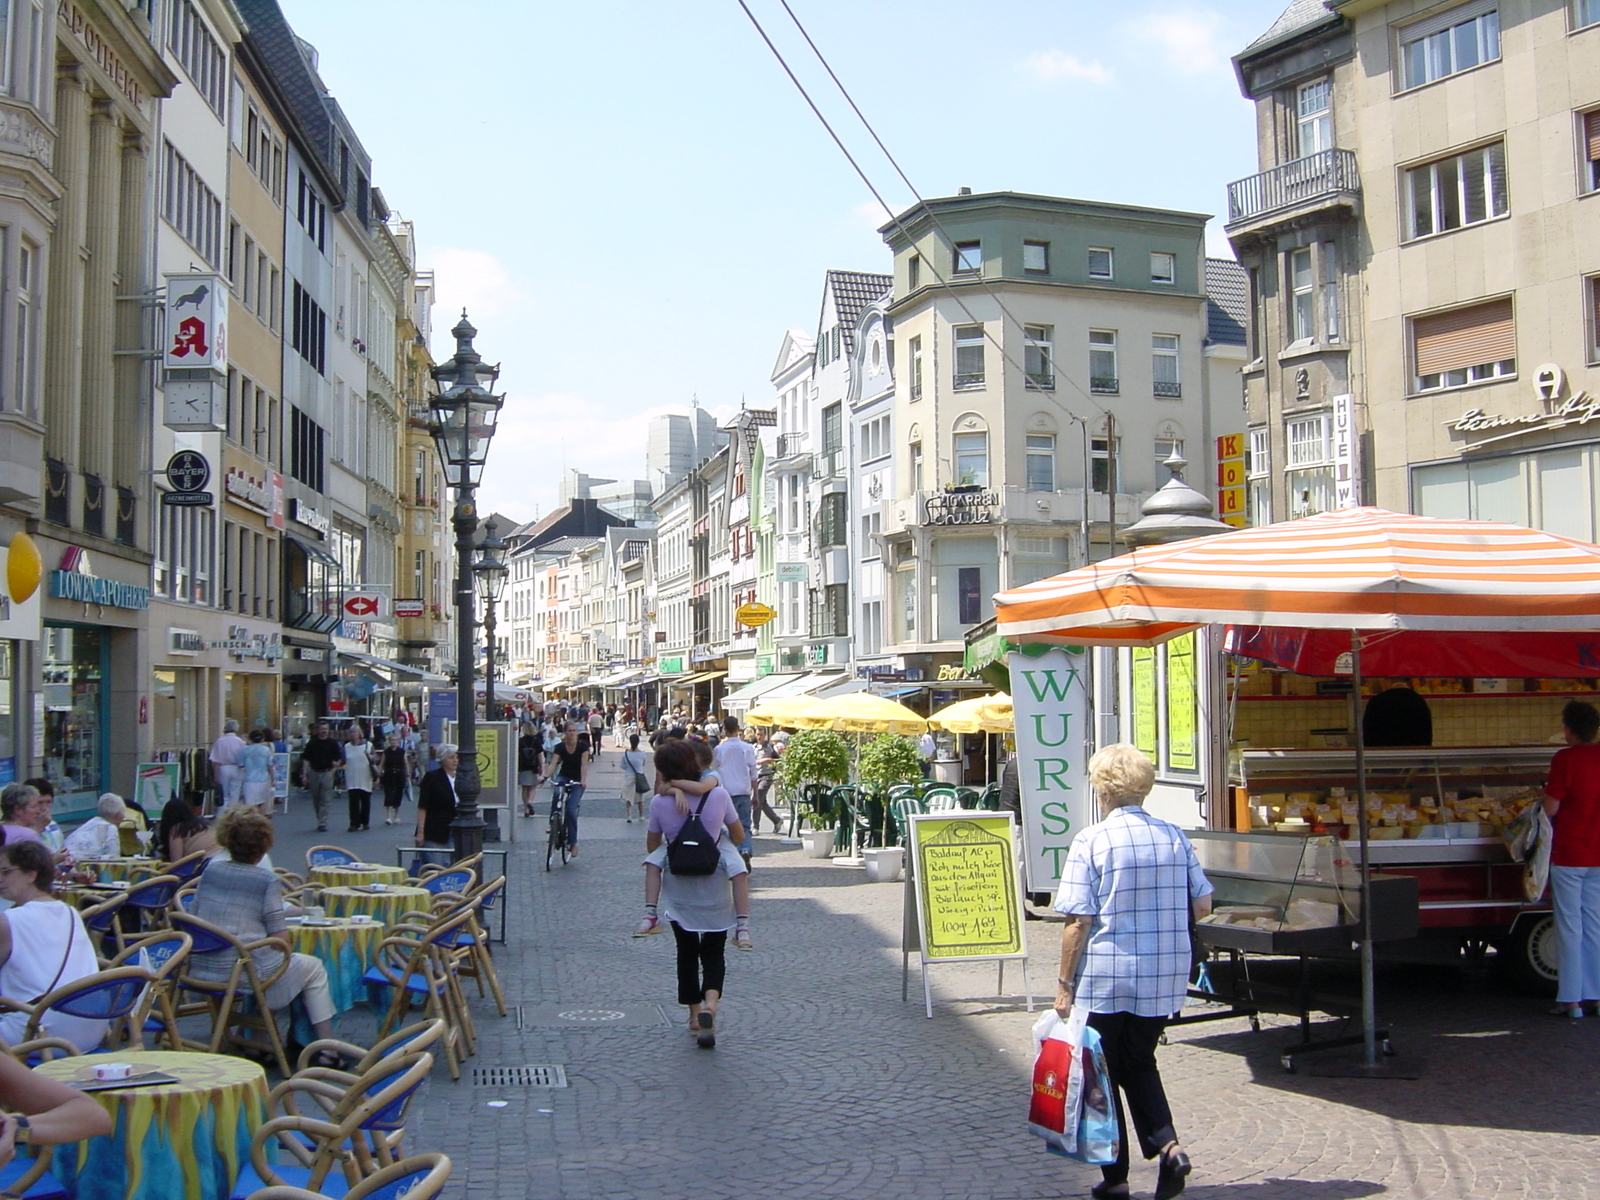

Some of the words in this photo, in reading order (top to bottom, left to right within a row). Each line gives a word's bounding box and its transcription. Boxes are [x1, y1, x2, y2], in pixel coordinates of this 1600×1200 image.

[58, 0, 143, 112] APOTHEKE
[1557, 390, 1600, 424] Aig
[1336, 398, 1348, 458] HÜTE
[170, 468, 206, 476] BAYER
[183, 454, 192, 489] BAYER
[1224, 435, 1238, 526] Kod
[1338, 487, 1349, 507] W
[1020, 669, 1080, 880] WURST
[156, 947, 173, 959] EIS
